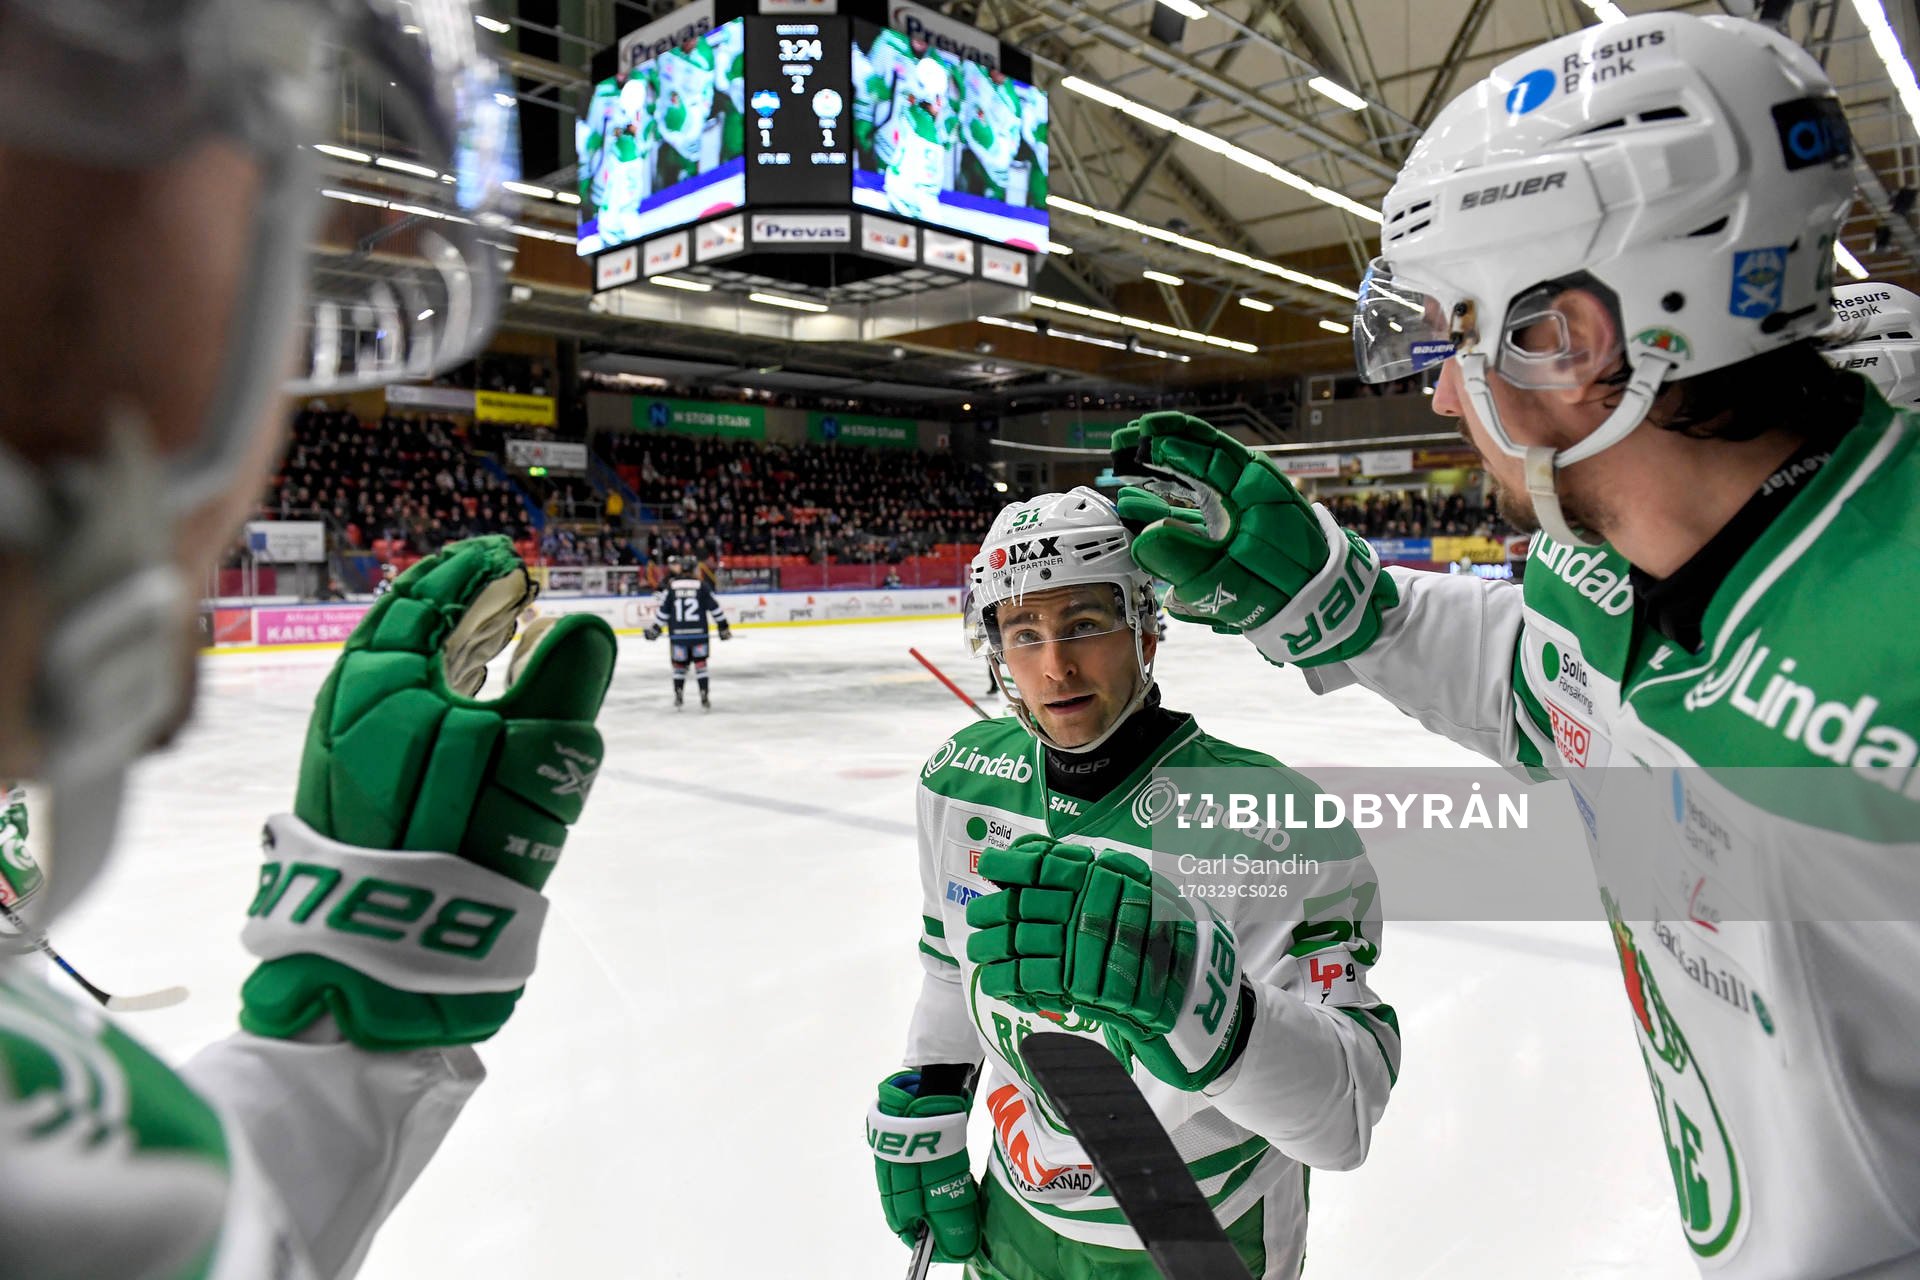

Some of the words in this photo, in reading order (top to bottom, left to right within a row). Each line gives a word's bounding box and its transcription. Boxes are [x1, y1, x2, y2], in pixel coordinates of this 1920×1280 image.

[778, 39, 823, 61] 3:24
[791, 75, 805, 94] 2
[1563, 57, 1636, 95] Bnk
[822, 129, 835, 147] 1
[1458, 171, 1568, 211] BAUER
[766, 224, 847, 241] Prevas
[1832, 291, 1891, 311] Resurs
[1838, 304, 1882, 322] Bank
[992, 570, 1007, 579] DIN
[1009, 556, 1064, 574] IT-PARTNER
[1536, 531, 1634, 616] Lindab
[673, 597, 700, 622] 12
[1729, 645, 1920, 803] Linda
[951, 746, 1033, 784] Lindab
[1049, 796, 1081, 817] SHL
[989, 820, 1012, 840] Solid
[930, 1173, 972, 1197] NEXUS
